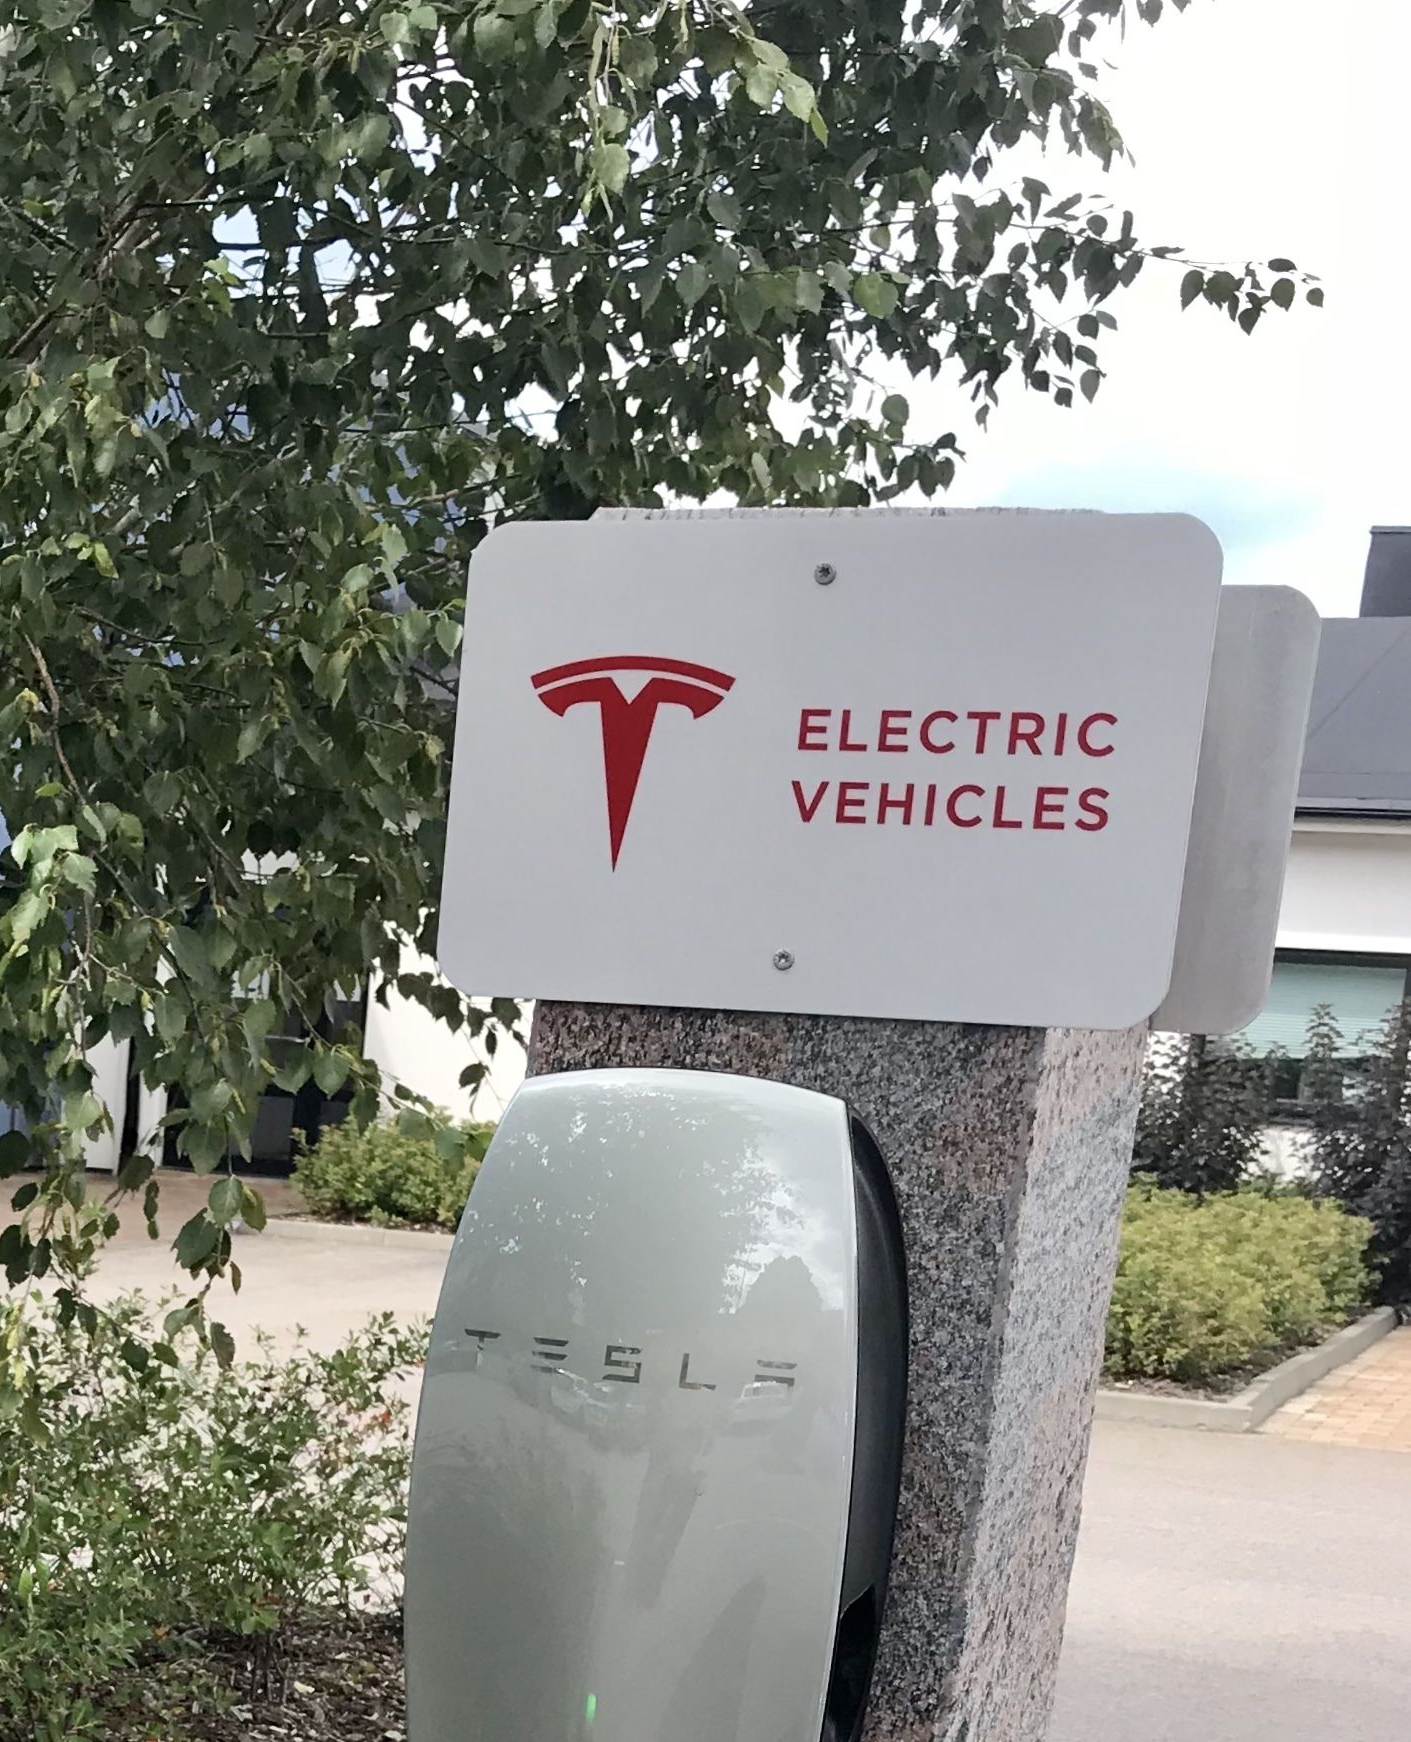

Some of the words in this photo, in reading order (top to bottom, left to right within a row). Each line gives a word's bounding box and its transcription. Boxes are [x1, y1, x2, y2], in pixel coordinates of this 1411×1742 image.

[798, 708, 1118, 758] ELECTRIC
[791, 780, 1109, 832] VEHICLES
[464, 1328, 798, 1397] TESLA
